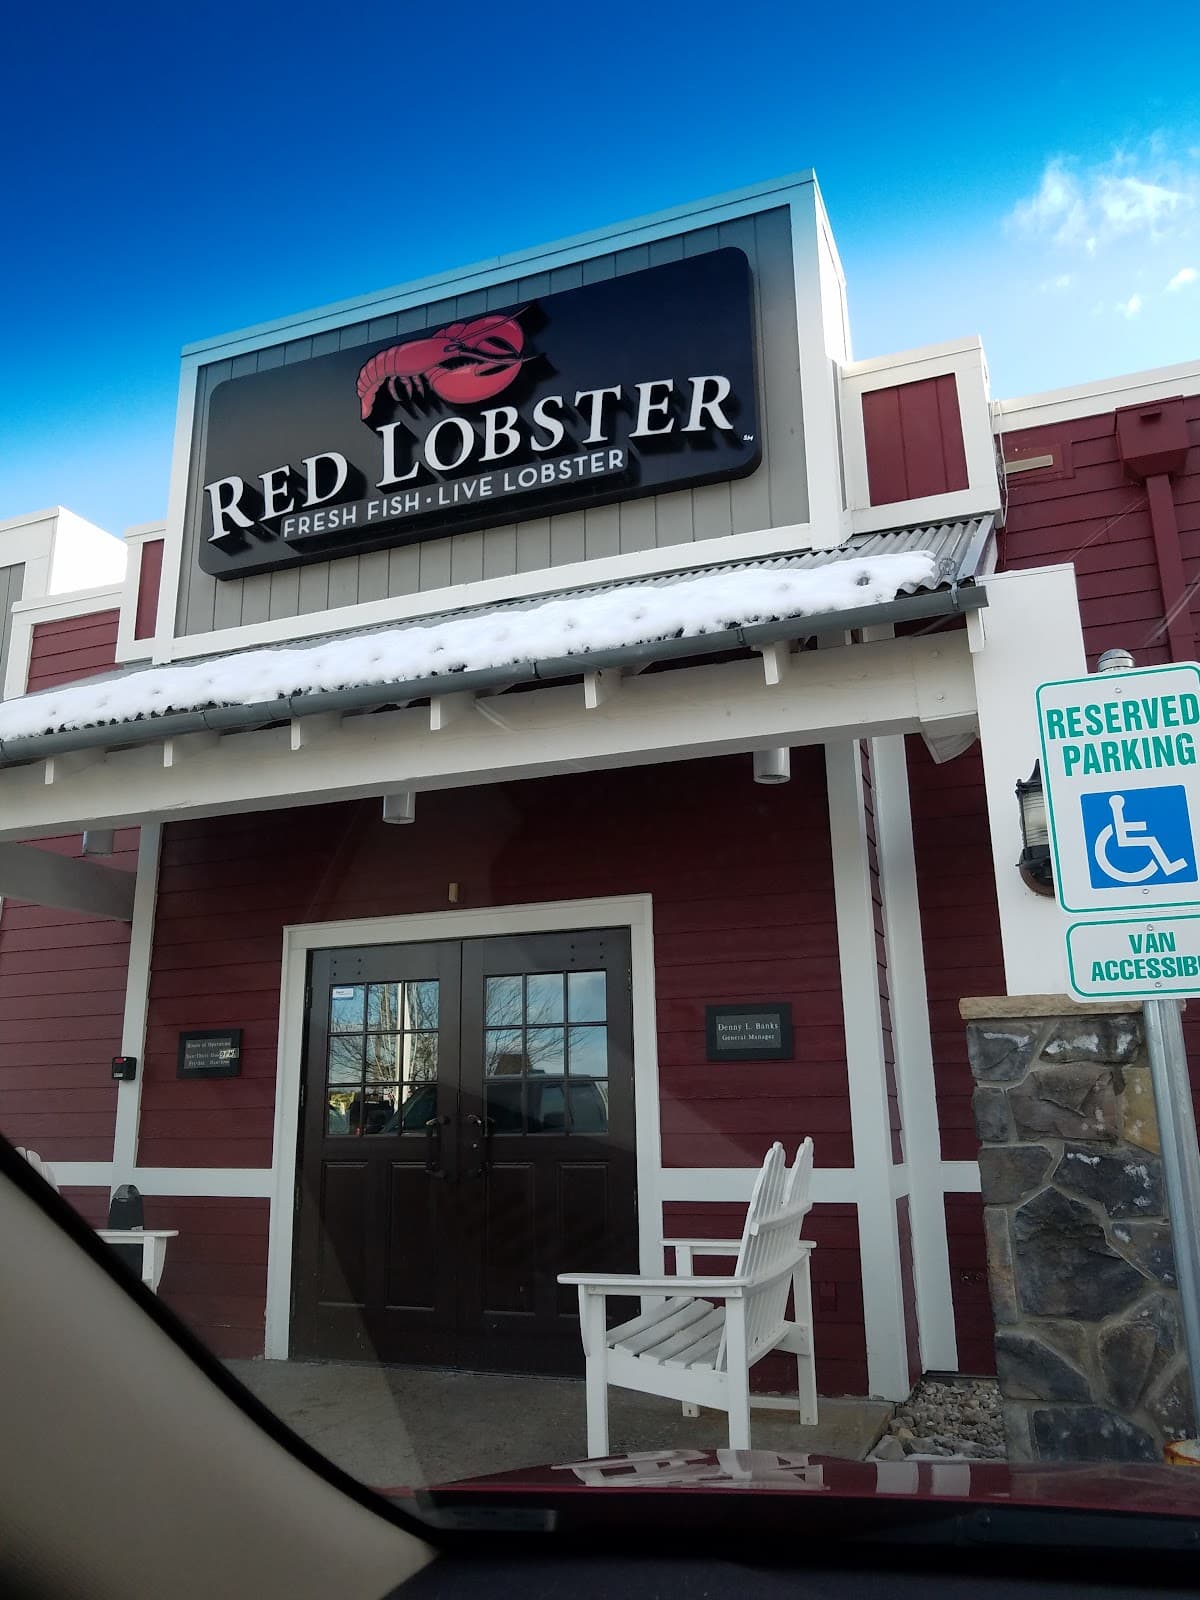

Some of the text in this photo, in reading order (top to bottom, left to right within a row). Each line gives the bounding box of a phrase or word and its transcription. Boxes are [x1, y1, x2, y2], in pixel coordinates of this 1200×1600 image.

[204, 450, 348, 542] RED
[376, 375, 734, 487] LOBSTER
[283, 449, 624, 538] FRESH FISH LIVE LOBSTER
[1046, 693, 1200, 740] RESERVED
[1063, 732, 1196, 777] PARKING
[1128, 931, 1176, 954] VAN
